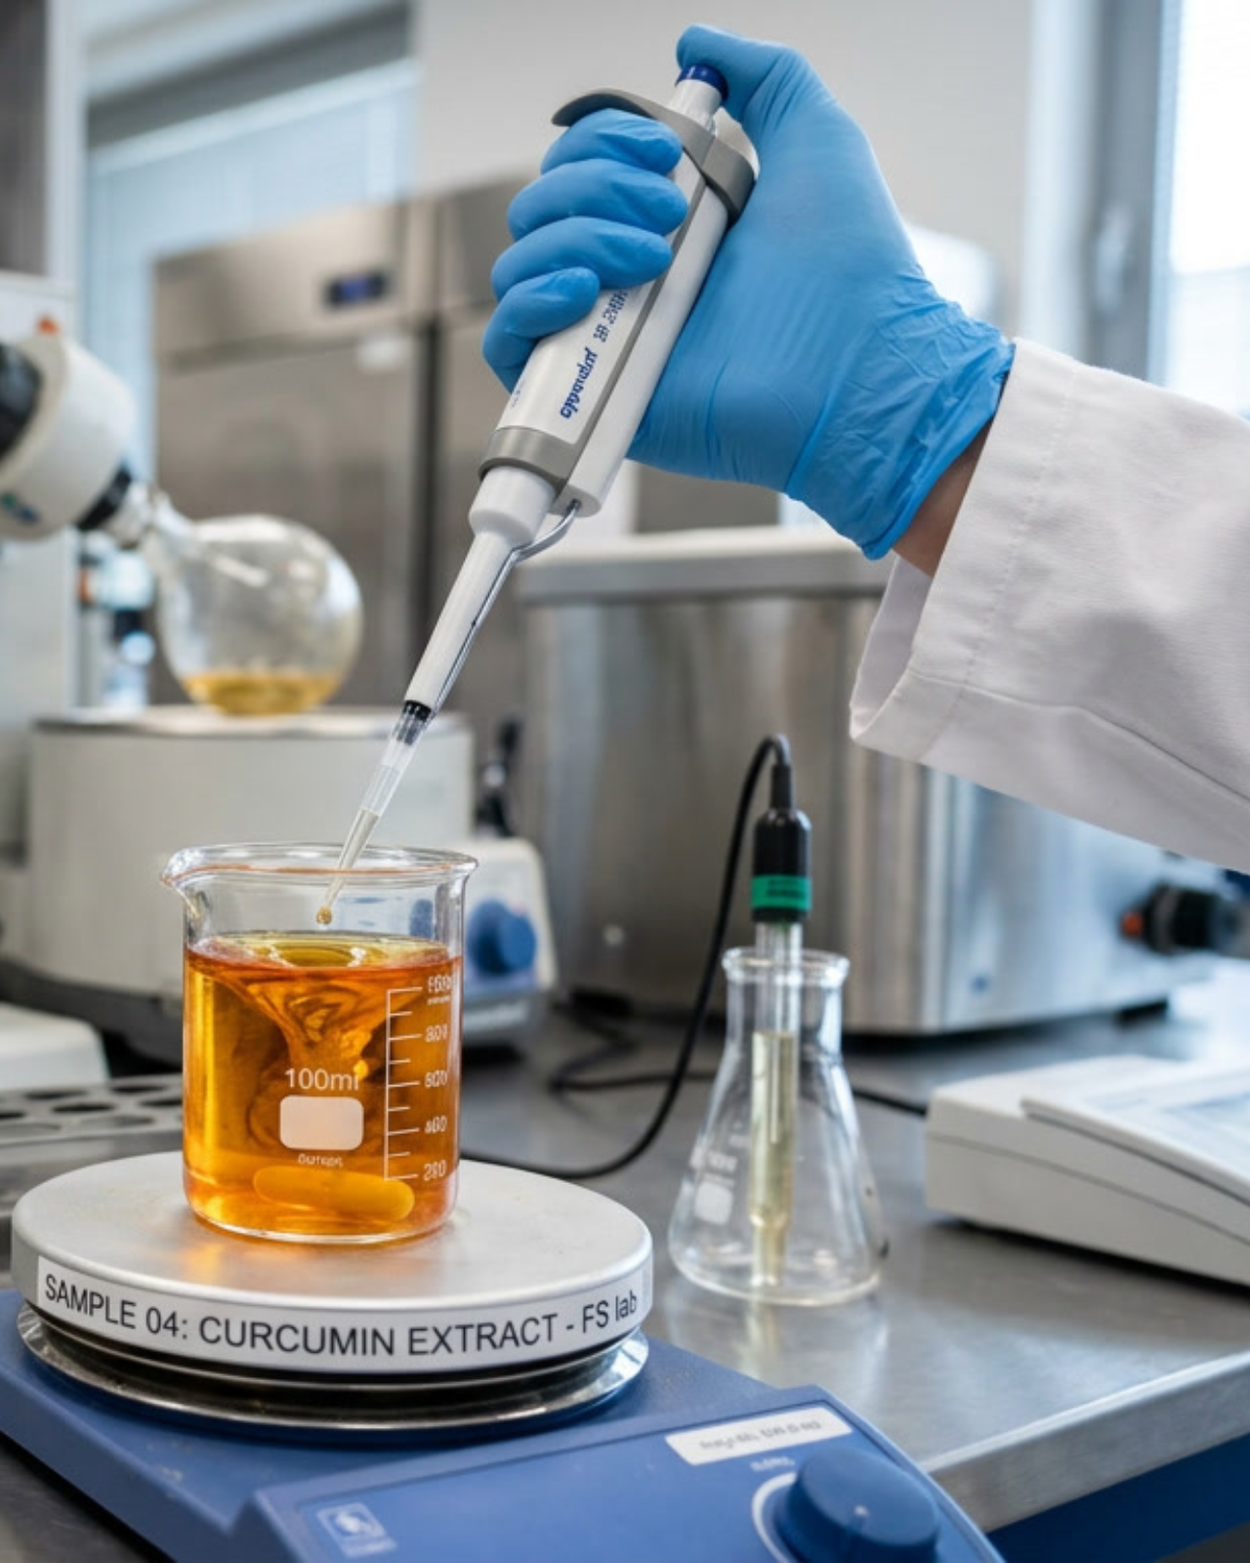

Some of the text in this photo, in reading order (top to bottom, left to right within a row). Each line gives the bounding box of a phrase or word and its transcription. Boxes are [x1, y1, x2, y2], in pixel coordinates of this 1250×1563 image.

[45, 1273, 137, 1330] SAMPLE
[145, 1306, 188, 1339] 04:
[199, 1315, 395, 1356] CURCUMIN
[407, 1313, 559, 1356] EXTRACT
[582, 1300, 610, 1334] FS
[615, 1290, 638, 1322] lab
